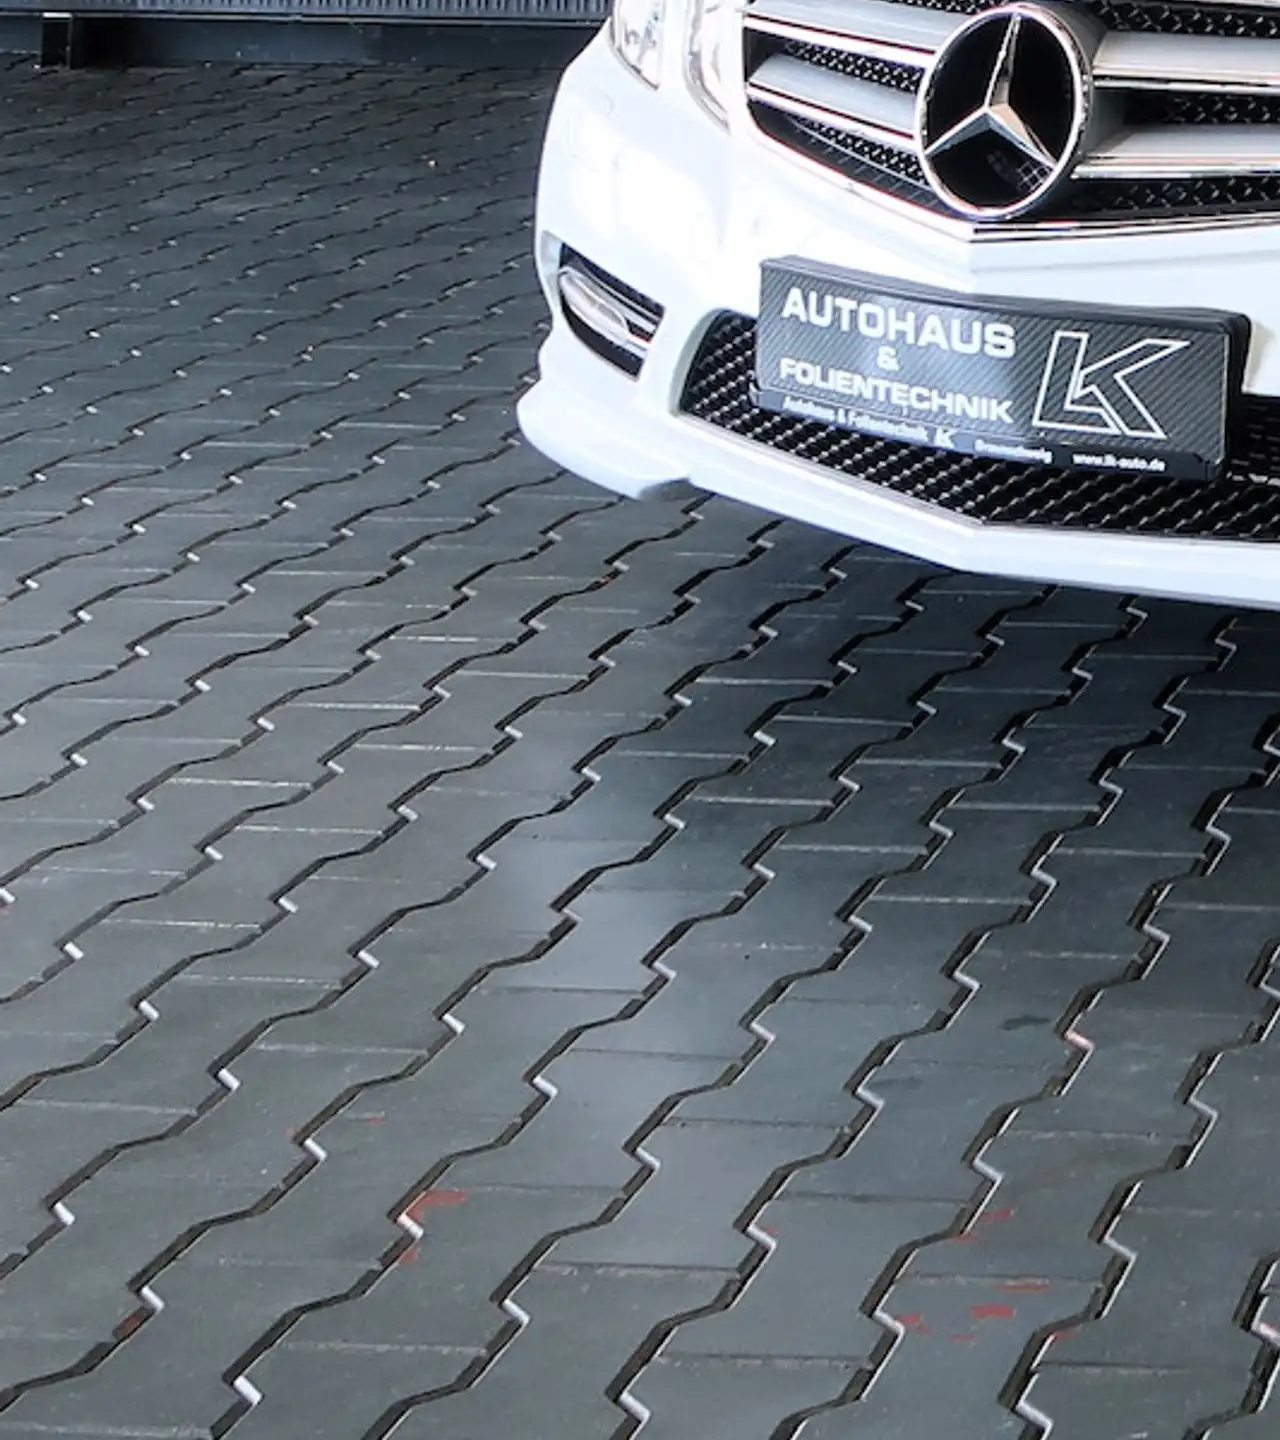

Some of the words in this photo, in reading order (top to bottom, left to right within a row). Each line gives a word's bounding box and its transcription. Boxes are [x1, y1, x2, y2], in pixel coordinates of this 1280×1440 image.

[780, 287, 1017, 359] AUTOHAUS
[779, 357, 1014, 424] FOLIENTECHNIK
[876, 345, 900, 371] &
